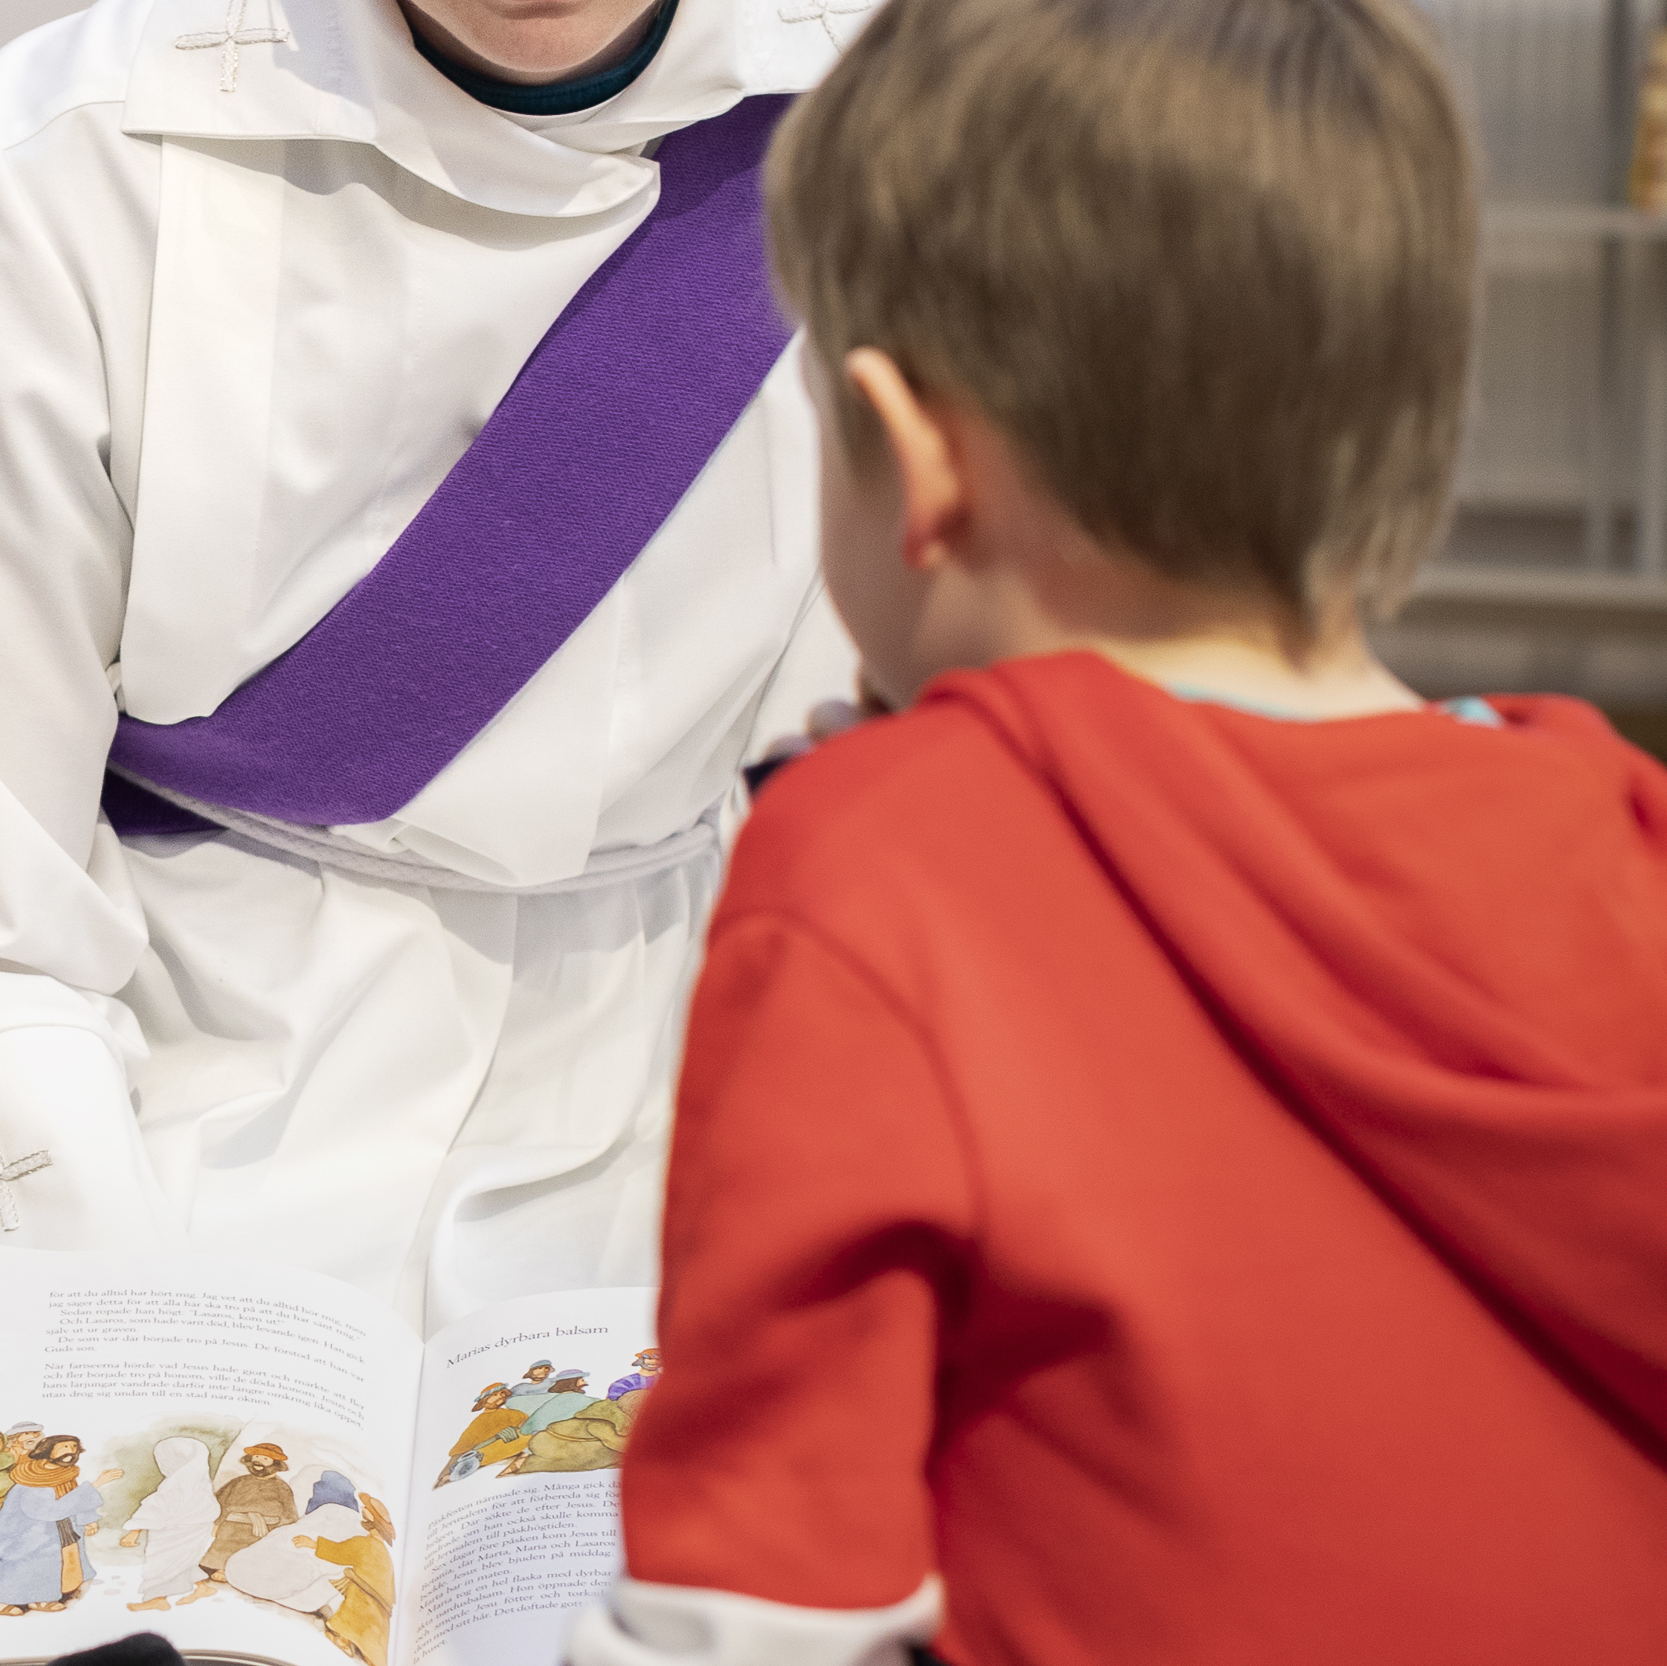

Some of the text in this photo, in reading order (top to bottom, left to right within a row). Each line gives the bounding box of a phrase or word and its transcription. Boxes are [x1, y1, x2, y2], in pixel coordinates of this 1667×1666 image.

[101, 1289, 128, 1297] alltid
[150, 1289, 173, 1297] hört
[202, 1292, 218, 1301] Jag
[256, 1298, 270, 1306] du
[273, 1301, 299, 1312] alltid
[60, 1308, 93, 1316] Sedan
[95, 1307, 132, 1316] ropade
[135, 1307, 155, 1315] han
[238, 1313, 263, 1323] kom
[184, 1300, 201, 1308] här
[204, 1301, 221, 1309] ska
[276, 1310, 290, 1319] du
[293, 1313, 309, 1323] har
[46, 1327, 69, 1336] själv
[59, 1317, 83, 1325] Och
[232, 1321, 254, 1330] blev
[256, 1324, 296, 1337] levande
[44, 1345, 74, 1353] Guds
[143, 1335, 183, 1343] började
[254, 1343, 271, 1351] De
[274, 1346, 311, 1360] förstod
[446, 1325, 608, 1369] Marias dyrbara balsam
[66, 1371, 84, 1379] fler
[86, 1371, 127, 1379] började
[249, 1378, 276, 1388] döda
[124, 1361, 156, 1369] hörde
[182, 1363, 209, 1371] Jesus
[212, 1364, 239, 1373] hade
[271, 1374, 291, 1382] och
[294, 1379, 330, 1392] märkte
[69, 1390, 94, 1398] drog
[114, 1389, 148, 1397] undan
[185, 1391, 208, 1399] stad
[70, 1381, 117, 1389] lärjungar
[121, 1380, 170, 1388] vandrade
[172, 1381, 205, 1389] därför
[232, 1384, 265, 1395] längre
[267, 1392, 311, 1407] omkring
